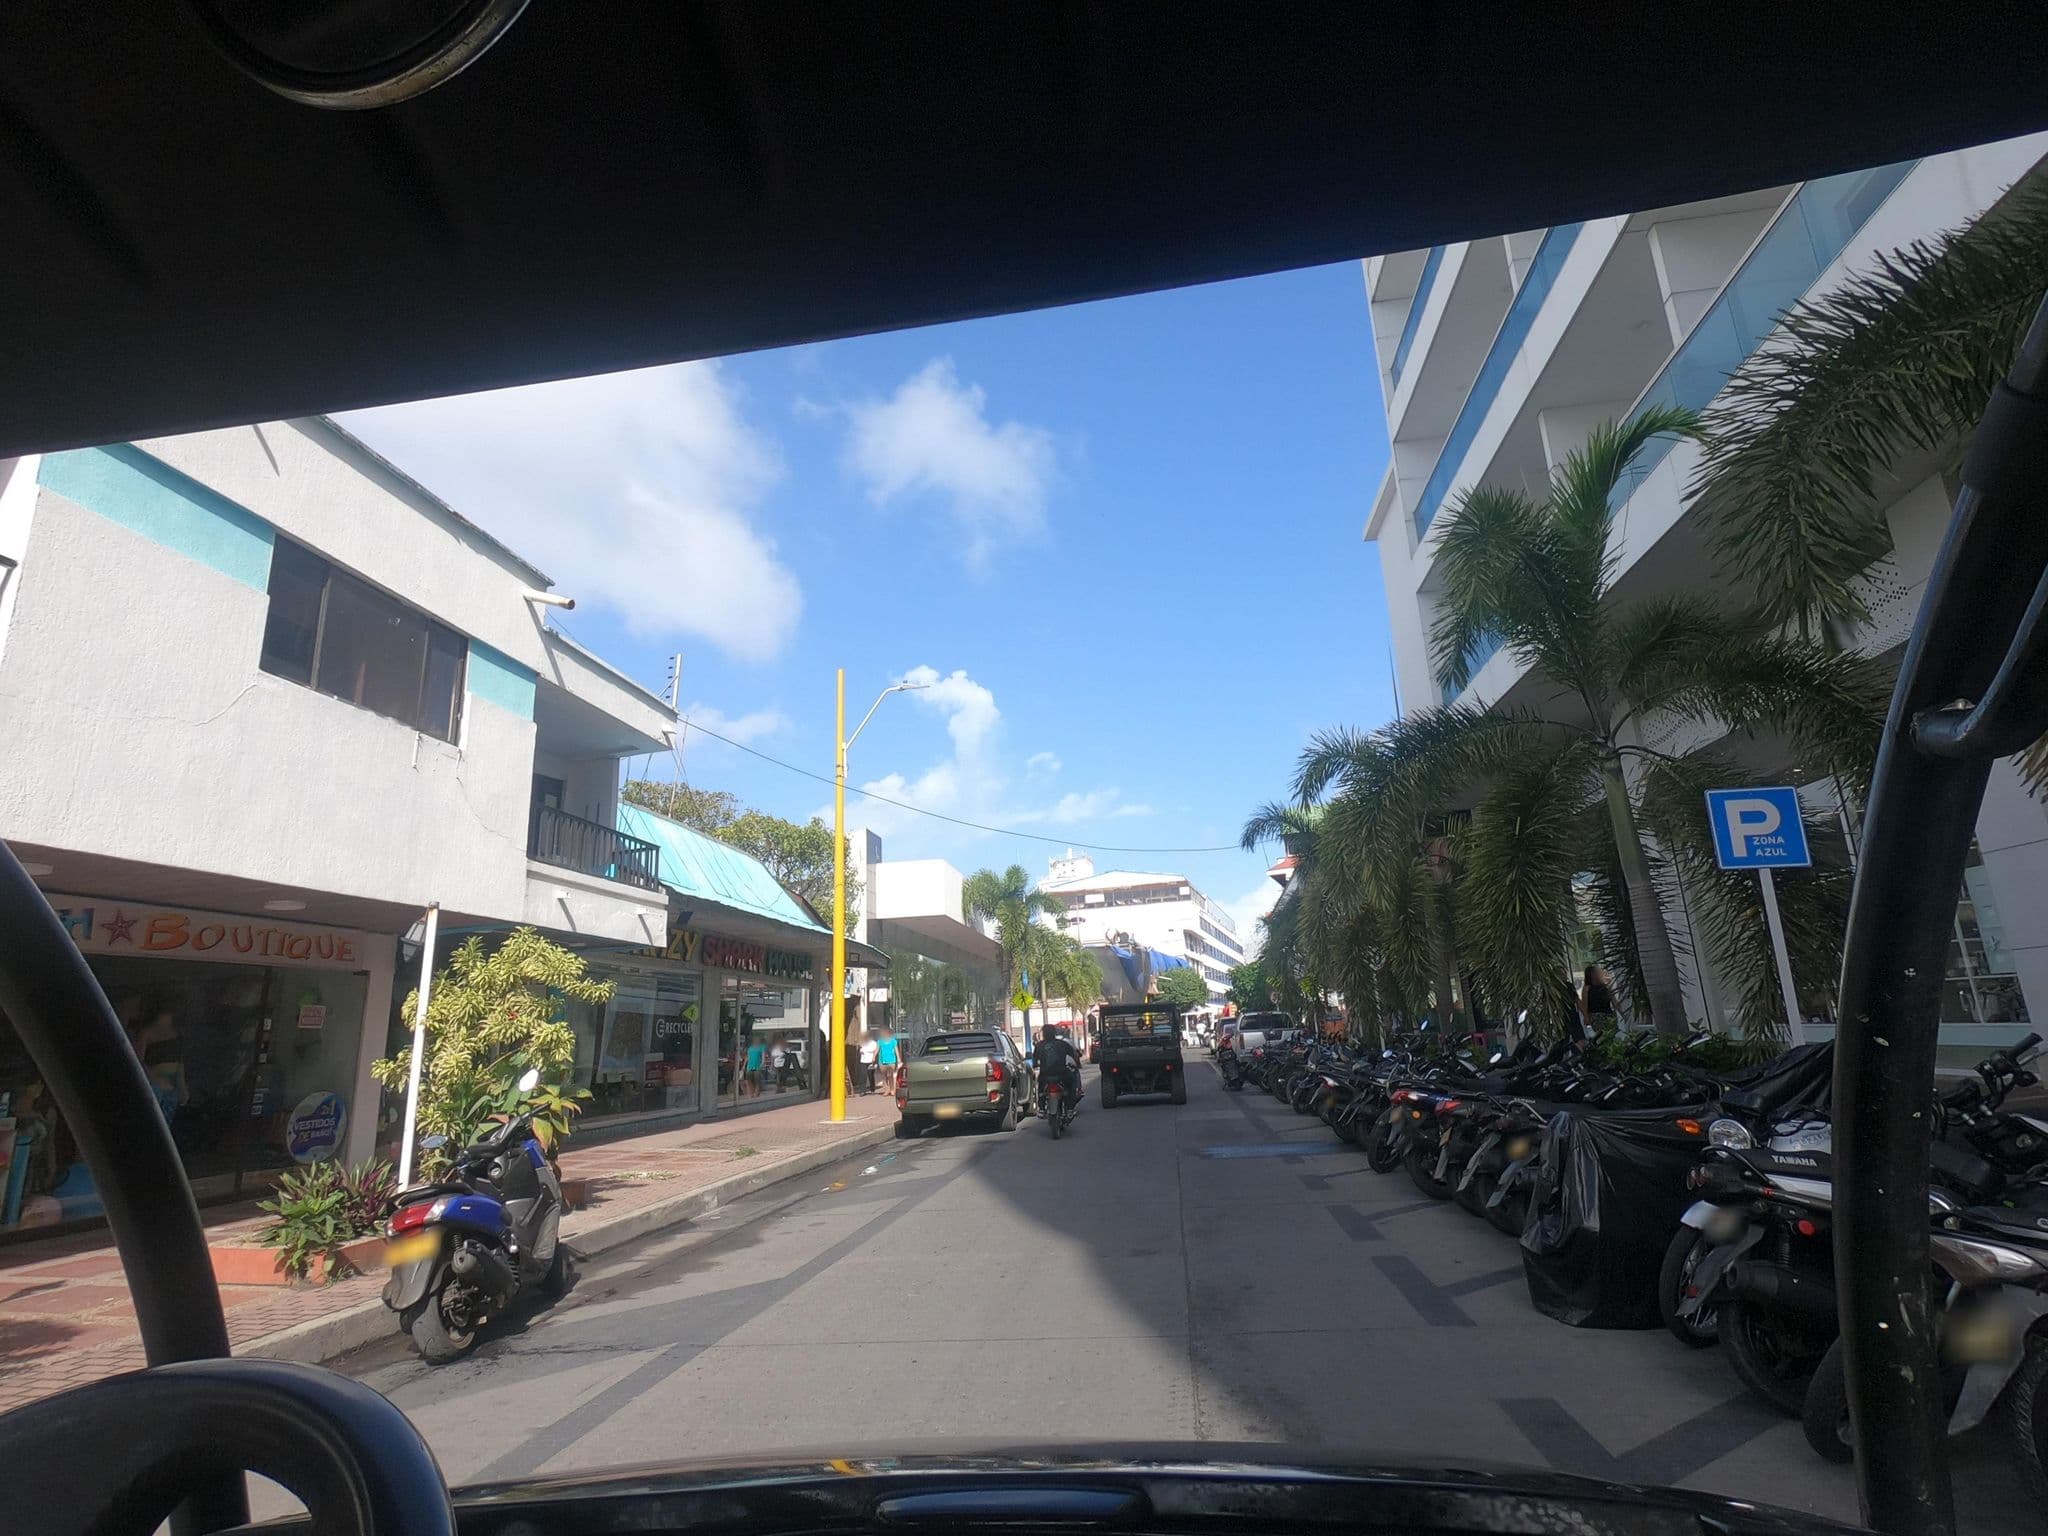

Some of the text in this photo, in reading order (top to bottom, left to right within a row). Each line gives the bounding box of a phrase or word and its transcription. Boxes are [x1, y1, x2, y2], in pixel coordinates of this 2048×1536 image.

[1724, 799, 1781, 858] P
[1752, 835, 1785, 846] ZONA
[1755, 848, 1788, 857] AZUL
[141, 912, 356, 963] BOUTIQUE
[294, 1118, 336, 1130] VESTIDOS
[1771, 1155, 1818, 1167] YAMAHA
